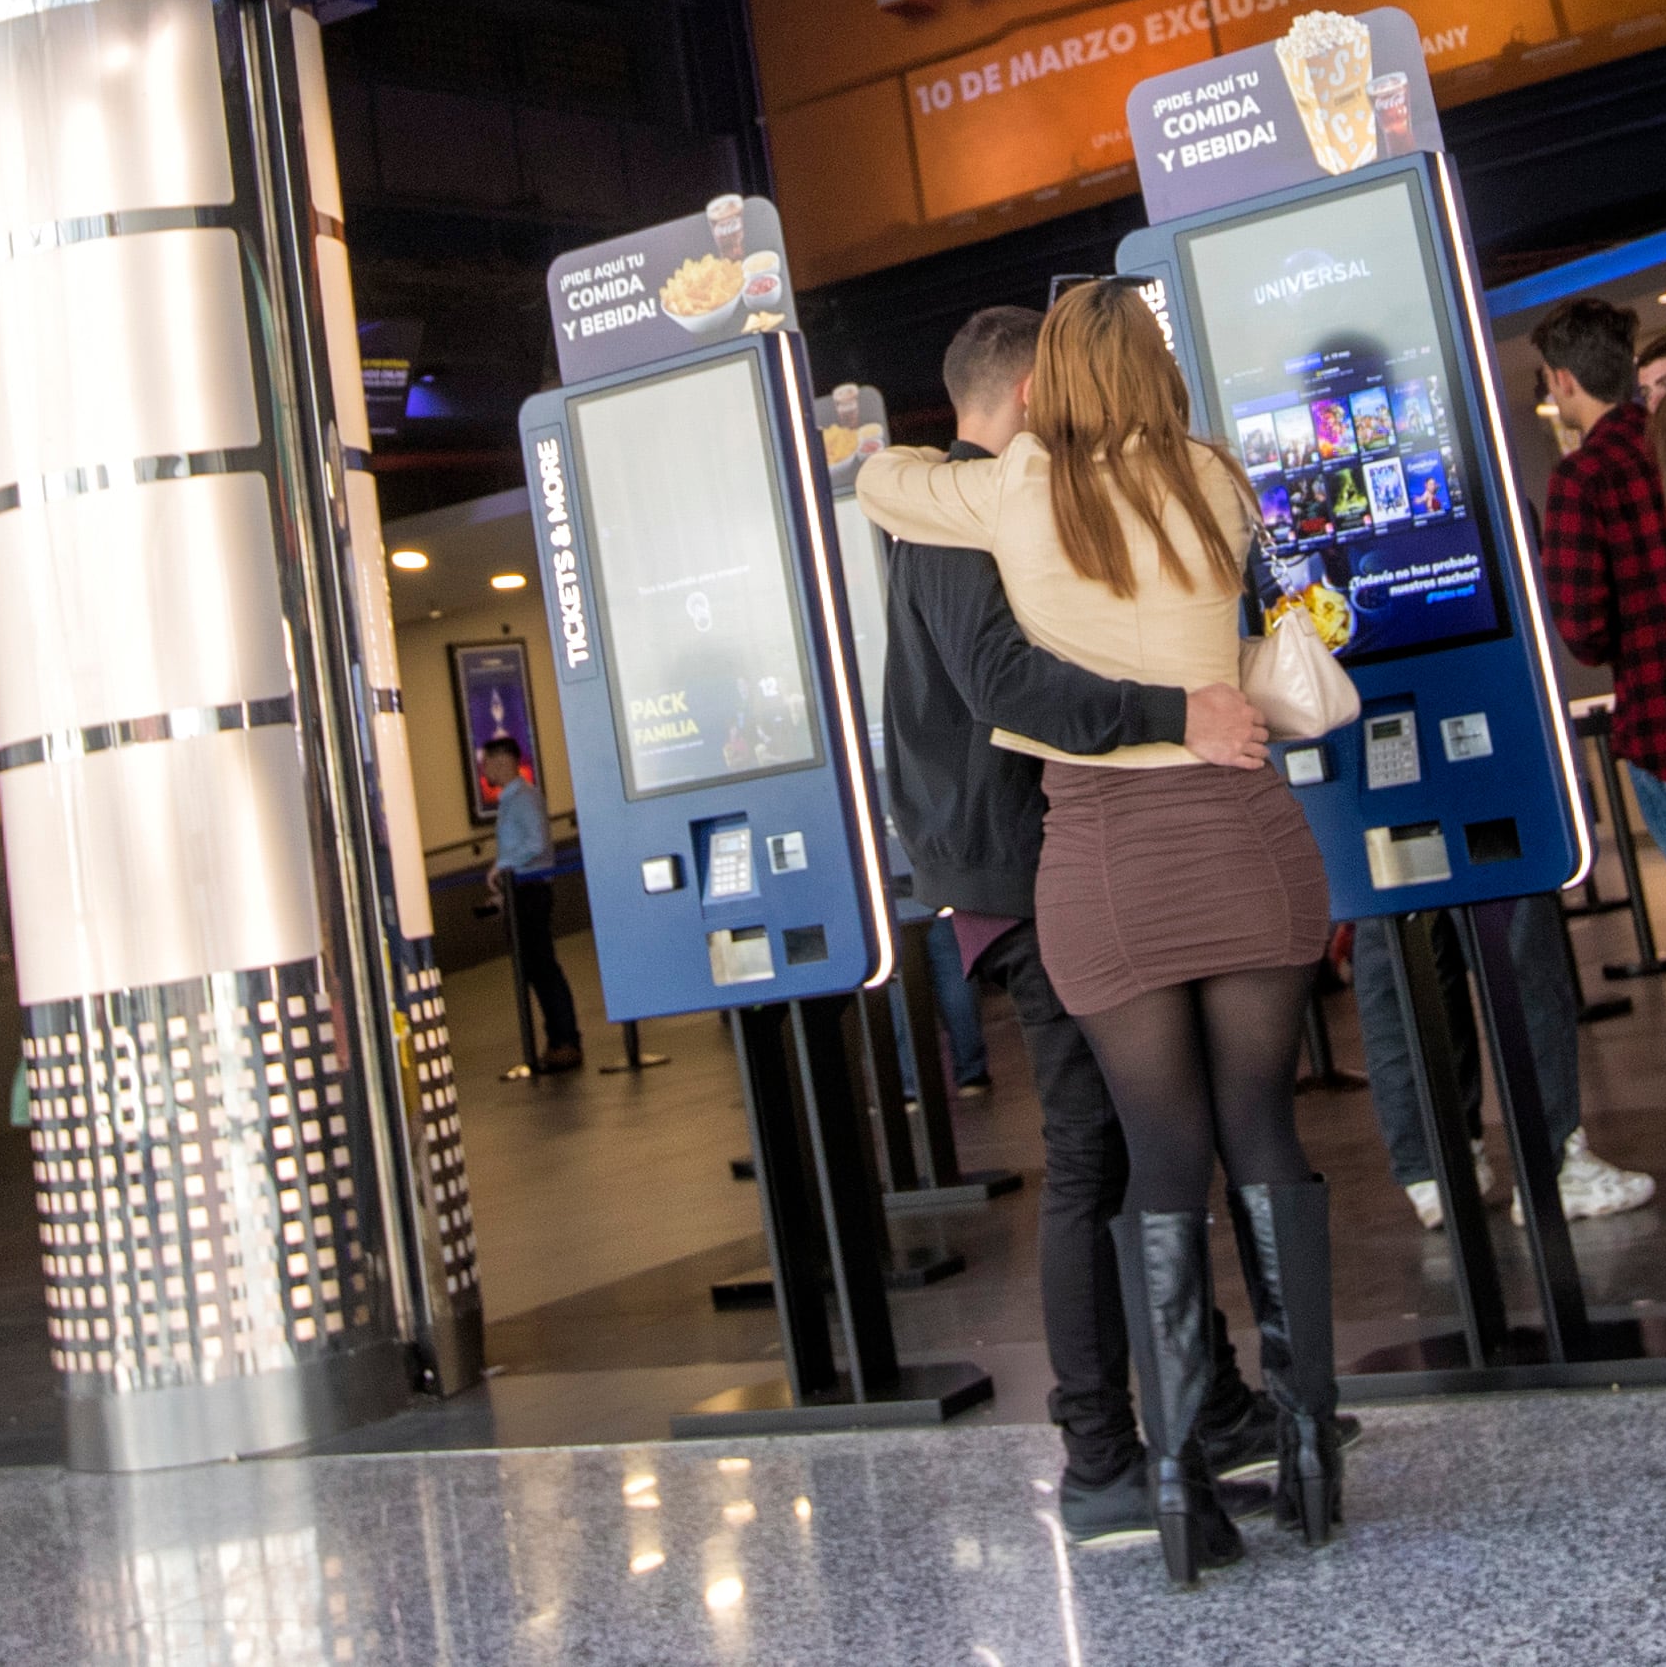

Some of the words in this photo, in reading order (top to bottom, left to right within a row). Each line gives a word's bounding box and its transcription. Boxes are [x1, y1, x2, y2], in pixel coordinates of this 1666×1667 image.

[916, 78, 954, 116] 10
[957, 61, 1006, 102] DE
[1008, 19, 1138, 87] MARZO
[1152, 89, 1194, 119] ¡PIDE
[1195, 75, 1235, 103] AQUÍ
[1236, 71, 1259, 91] TU
[1162, 95, 1261, 140] COMIDA
[1157, 150, 1177, 173] Y
[1181, 120, 1277, 169] BEBIDA!
[559, 265, 593, 292] ¡PIDE
[593, 254, 627, 283] AQUÍ
[626, 252, 645, 272] TU
[567, 273, 646, 313] COMIDA
[1253, 257, 1372, 306] UNIVERSAL
[561, 320, 579, 342] Y
[579, 297, 658, 339] BEBIDA!
[536, 437, 568, 524] MORE
[549, 524, 572, 544] &
[1349, 569, 1395, 592] ¿Todavía
[1395, 568, 1411, 581] no
[1410, 563, 1431, 577] has
[1432, 553, 1479, 575] probado
[1389, 577, 1437, 597] nuestros
[1436, 566, 1481, 587] nachos?
[554, 542, 590, 669] TICKETS
[630, 690, 689, 722] PACK
[758, 676, 779, 698] 12
[634, 718, 700, 747] FAMILIA
